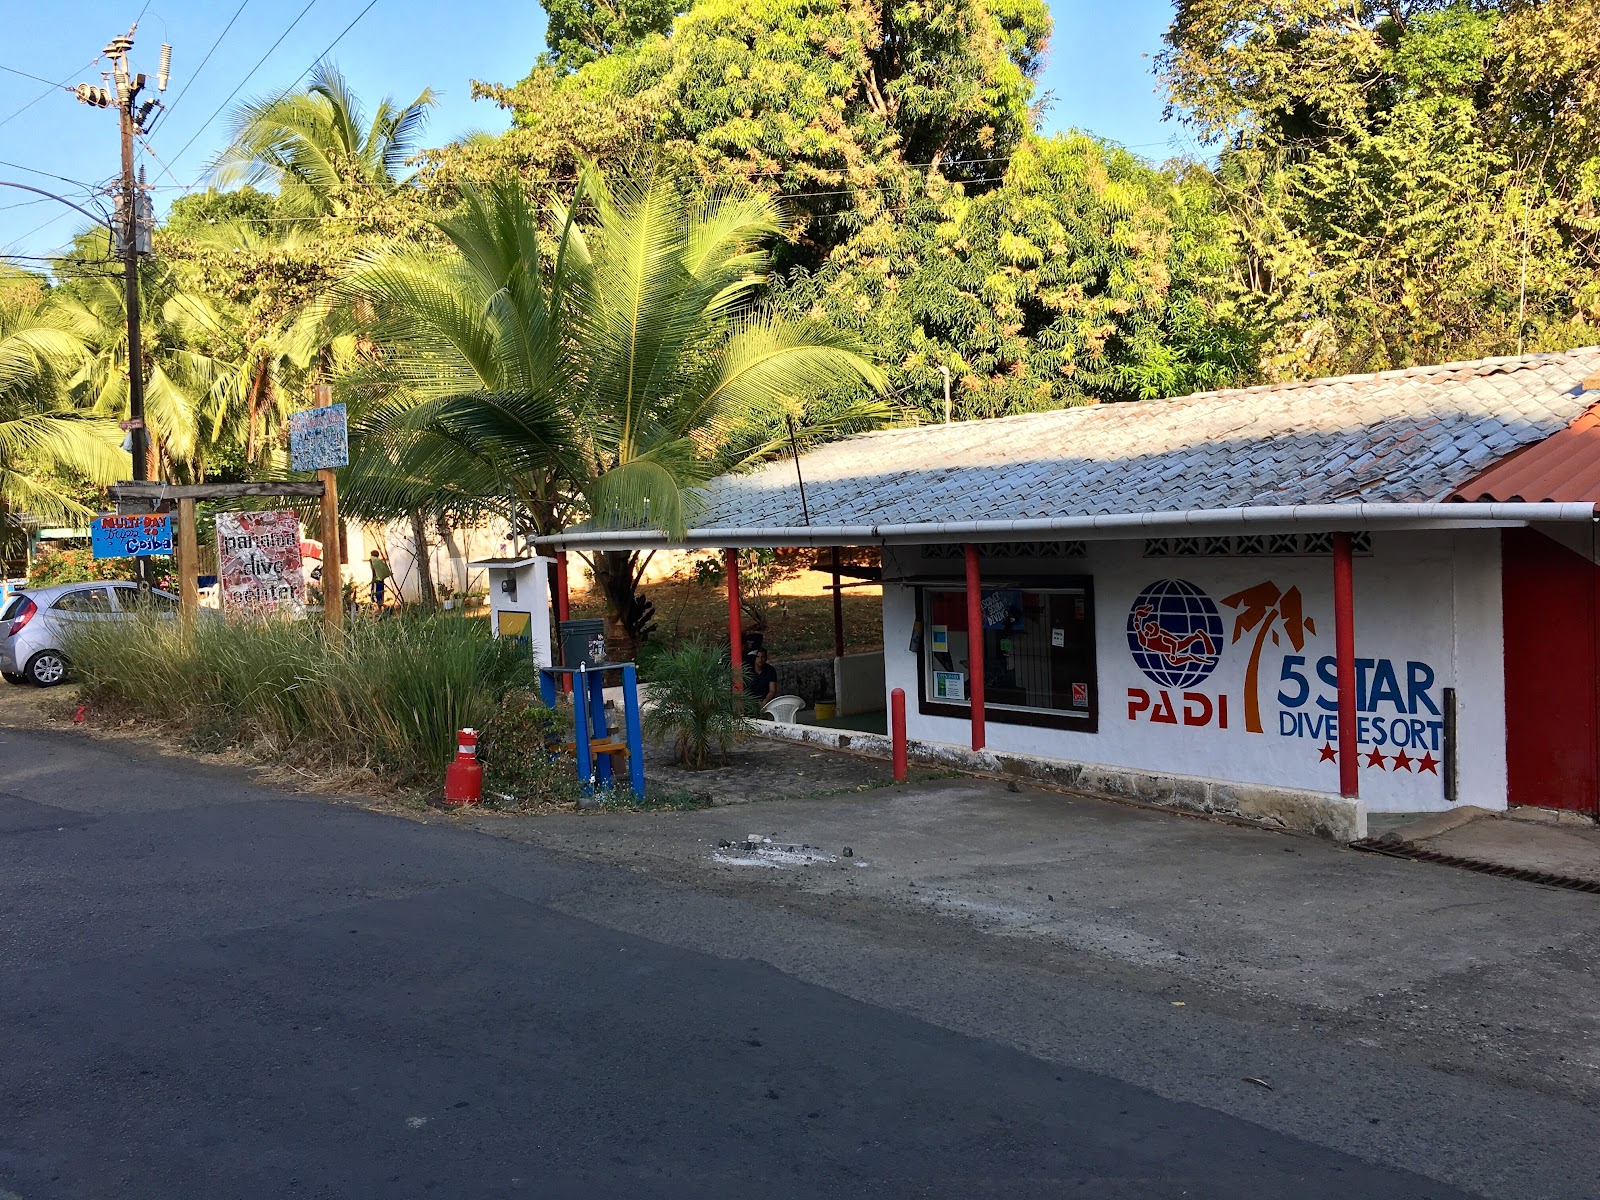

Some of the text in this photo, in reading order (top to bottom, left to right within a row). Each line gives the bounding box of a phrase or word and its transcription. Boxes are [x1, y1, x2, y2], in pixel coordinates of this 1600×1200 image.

[102, 515, 167, 529] MULTI-DAY
[125, 536, 172, 554] Coiba
[225, 533, 295, 555] panama
[243, 554, 283, 576] dive
[233, 585, 297, 603] center
[1277, 656, 1441, 715] 5 STAR
[1127, 688, 1228, 729] PADI
[1279, 711, 1444, 751] DIVE ESORT
